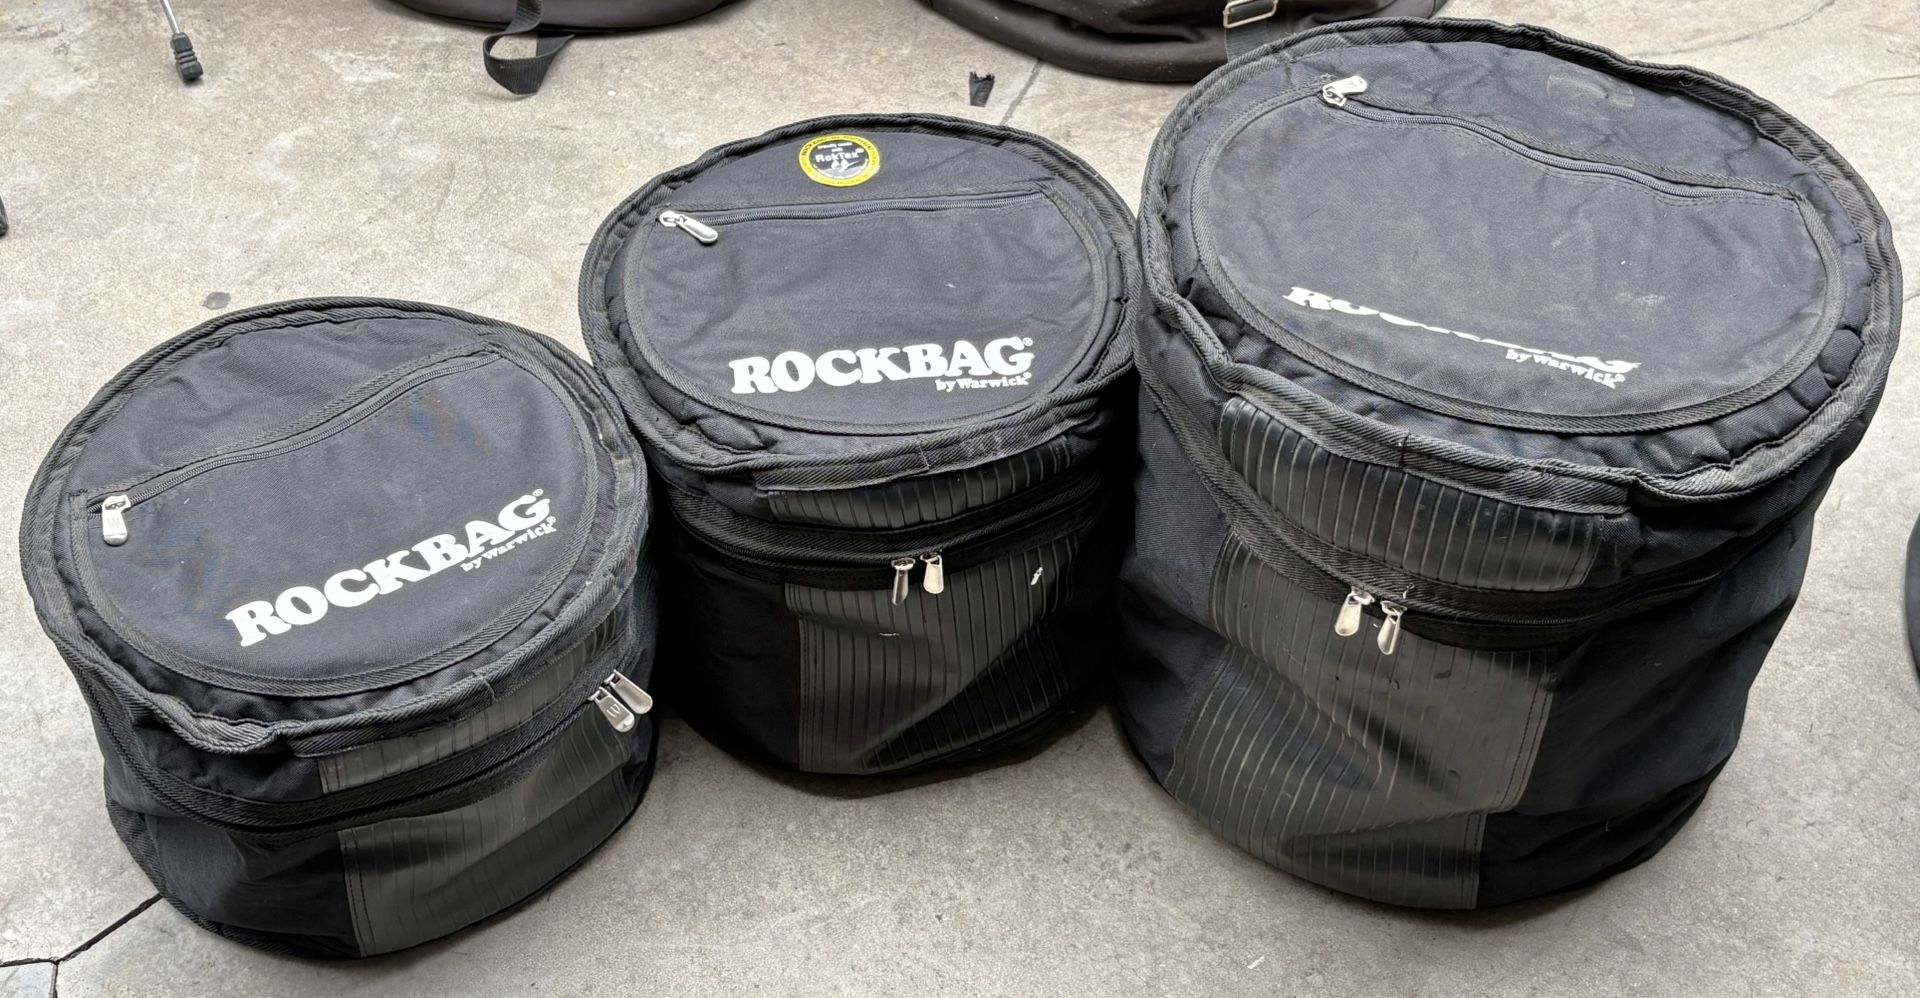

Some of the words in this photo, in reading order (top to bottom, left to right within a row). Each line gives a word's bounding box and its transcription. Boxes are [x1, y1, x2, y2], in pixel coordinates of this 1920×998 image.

[1505, 349, 1532, 362] by
[935, 378, 956, 392] by
[460, 557, 482, 572] by
